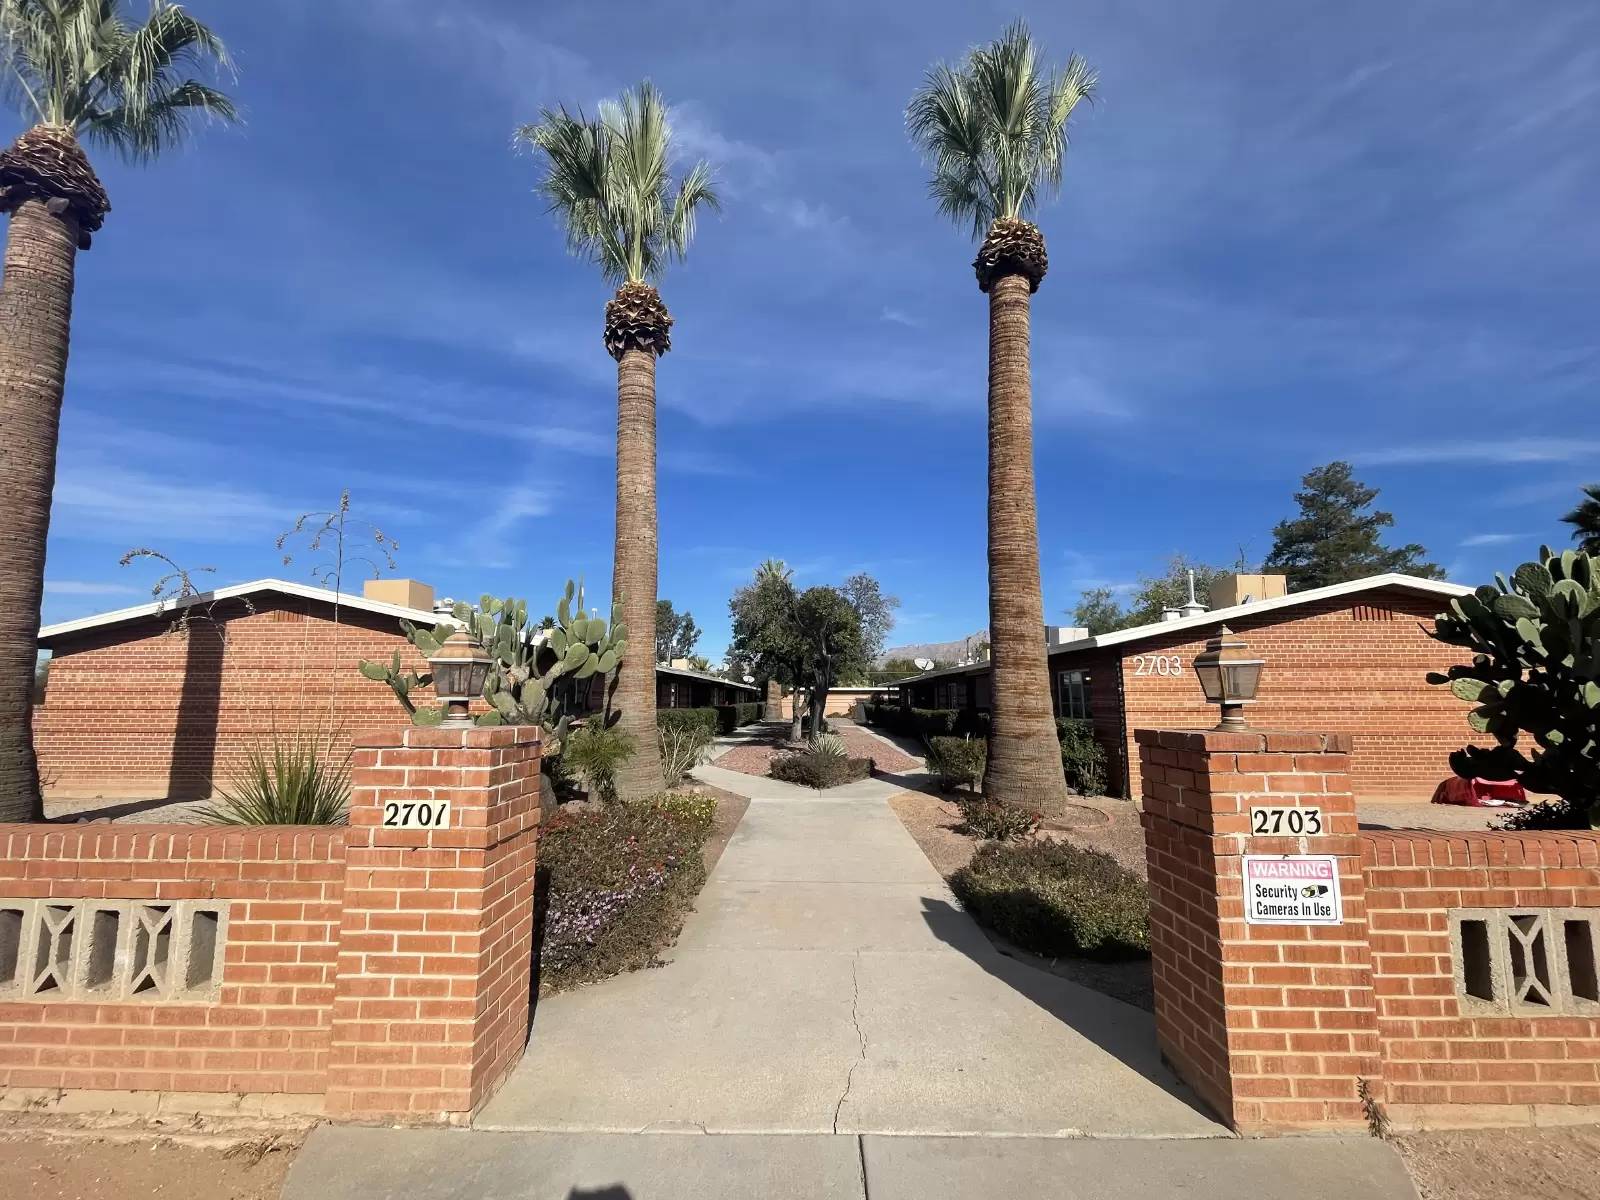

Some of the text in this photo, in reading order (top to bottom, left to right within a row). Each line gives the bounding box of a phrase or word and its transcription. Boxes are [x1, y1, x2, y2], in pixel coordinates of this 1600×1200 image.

[1133, 655, 1182, 676] 2703
[384, 802, 447, 826] 2701
[1253, 809, 1321, 835] 2703
[1252, 862, 1329, 877] WARNING
[1255, 883, 1298, 901] Security
[1256, 901, 1331, 916] Cameras In Use
